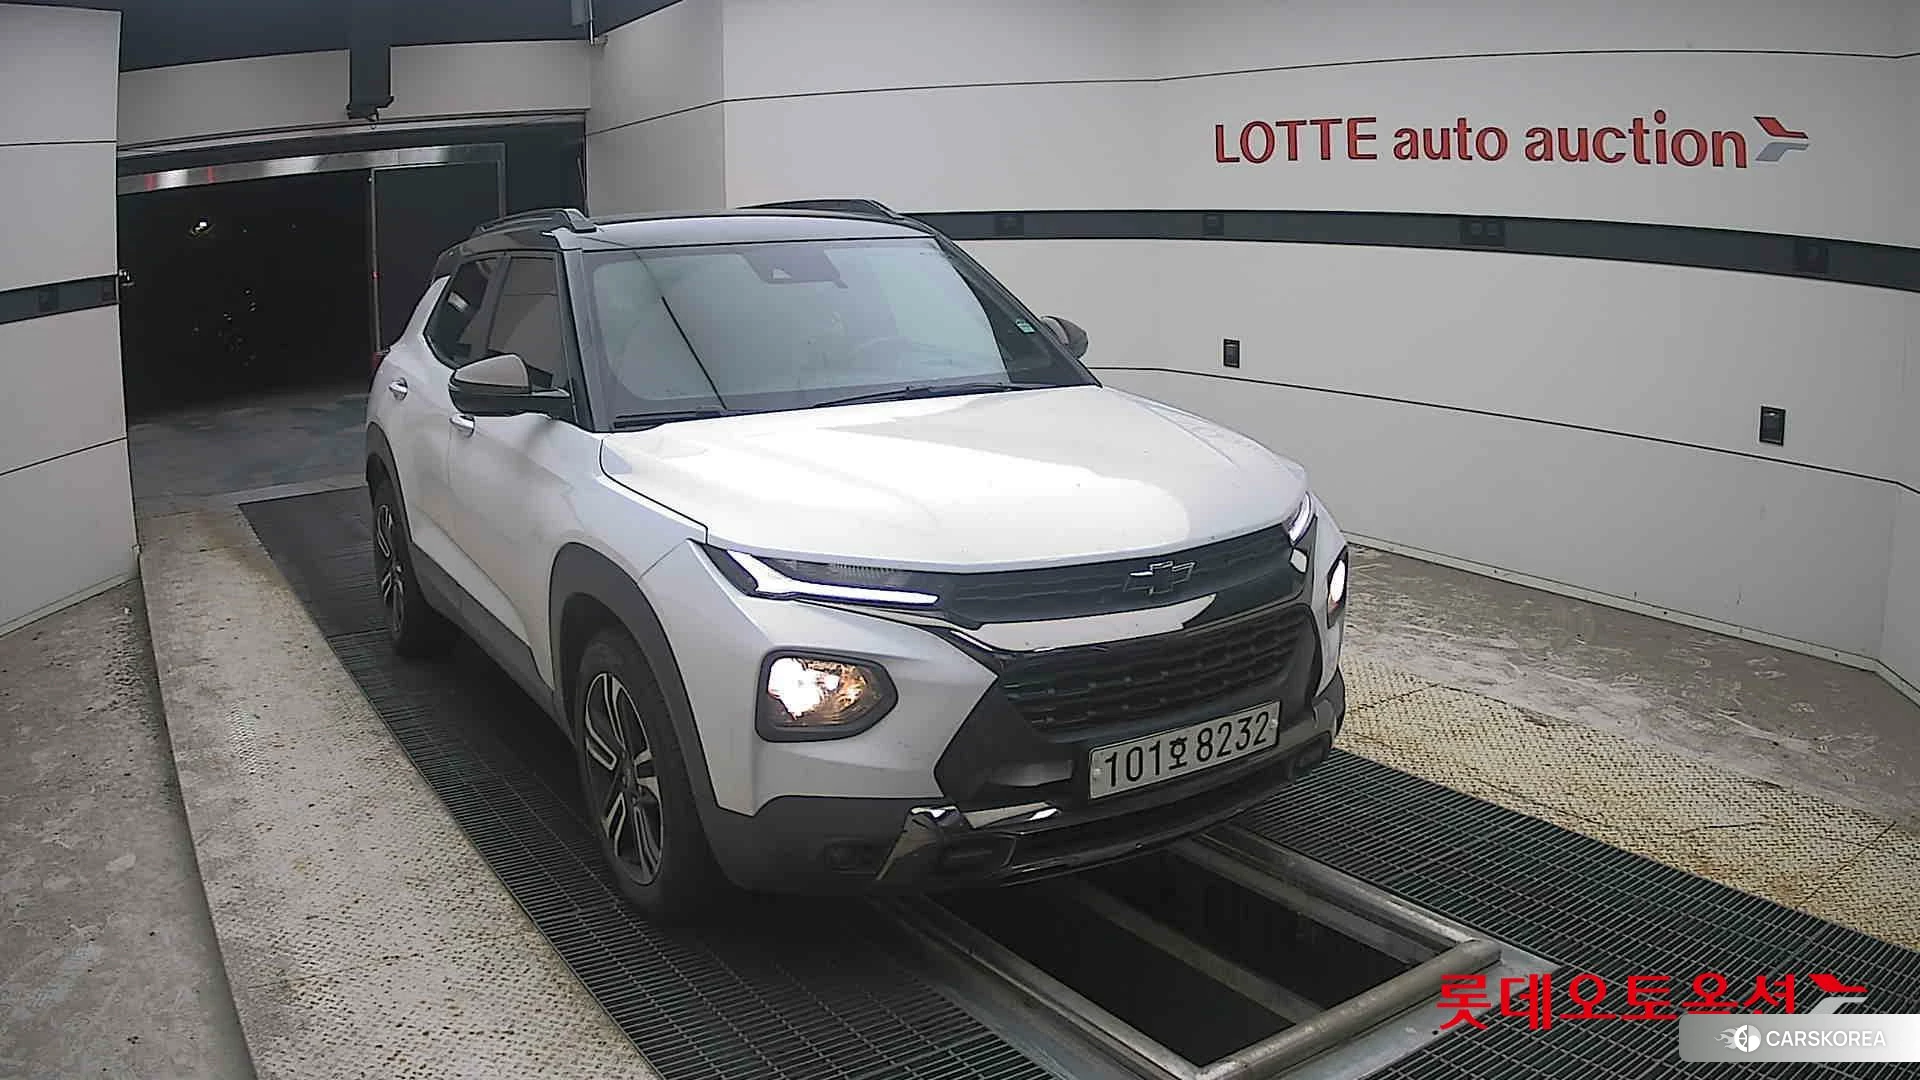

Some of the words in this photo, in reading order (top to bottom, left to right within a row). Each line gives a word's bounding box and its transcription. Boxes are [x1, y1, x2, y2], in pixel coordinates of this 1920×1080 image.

[1214, 116, 1378, 164] LOTTE
[1393, 117, 1510, 162] auto
[1523, 110, 1748, 168] auction
